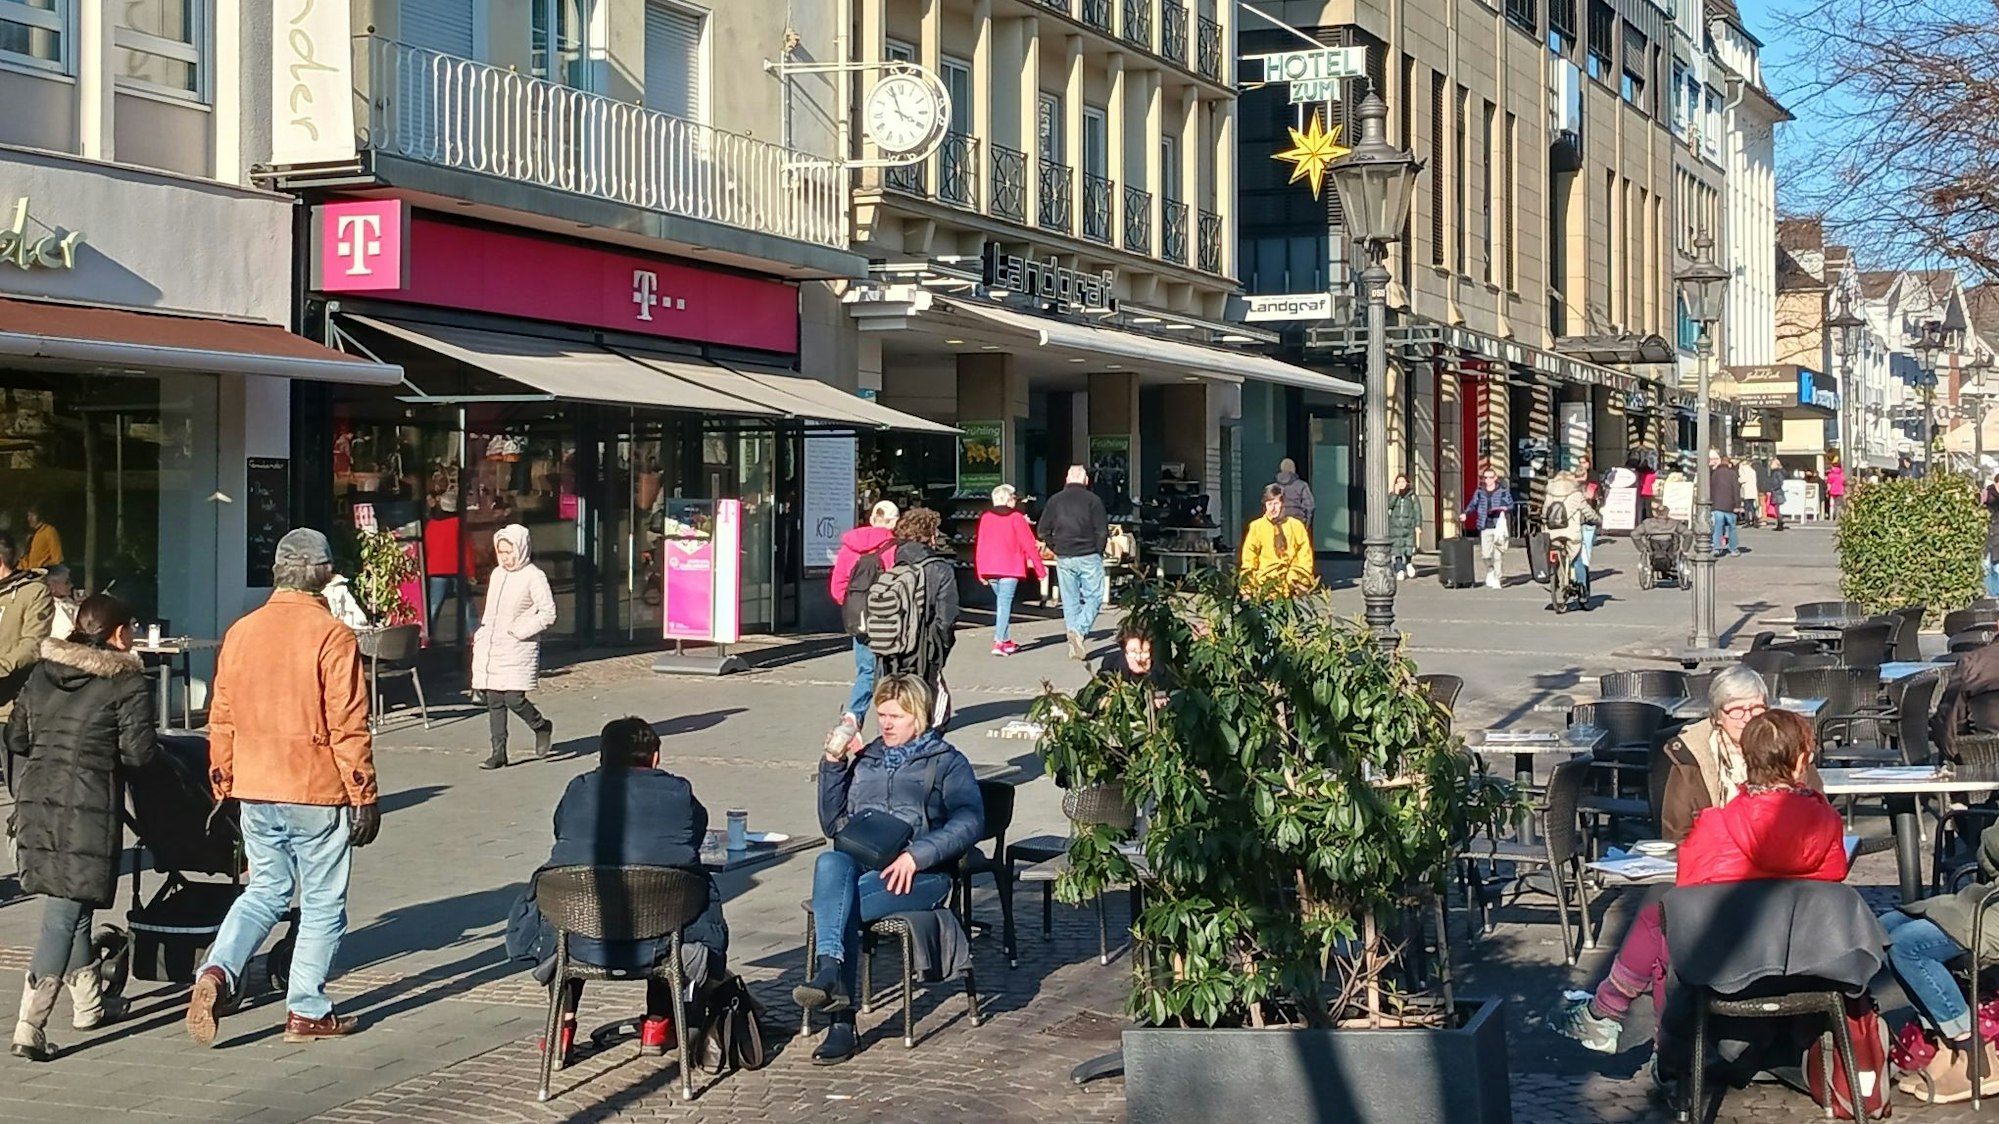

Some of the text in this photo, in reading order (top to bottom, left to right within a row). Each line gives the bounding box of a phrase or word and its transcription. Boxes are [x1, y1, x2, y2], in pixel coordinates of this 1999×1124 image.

[1266, 50, 1359, 81] HOTEL
[1292, 82, 1335, 101] ZUM
[989, 241, 1114, 315] Landgraf
[1249, 299, 1327, 315] Landgraf
